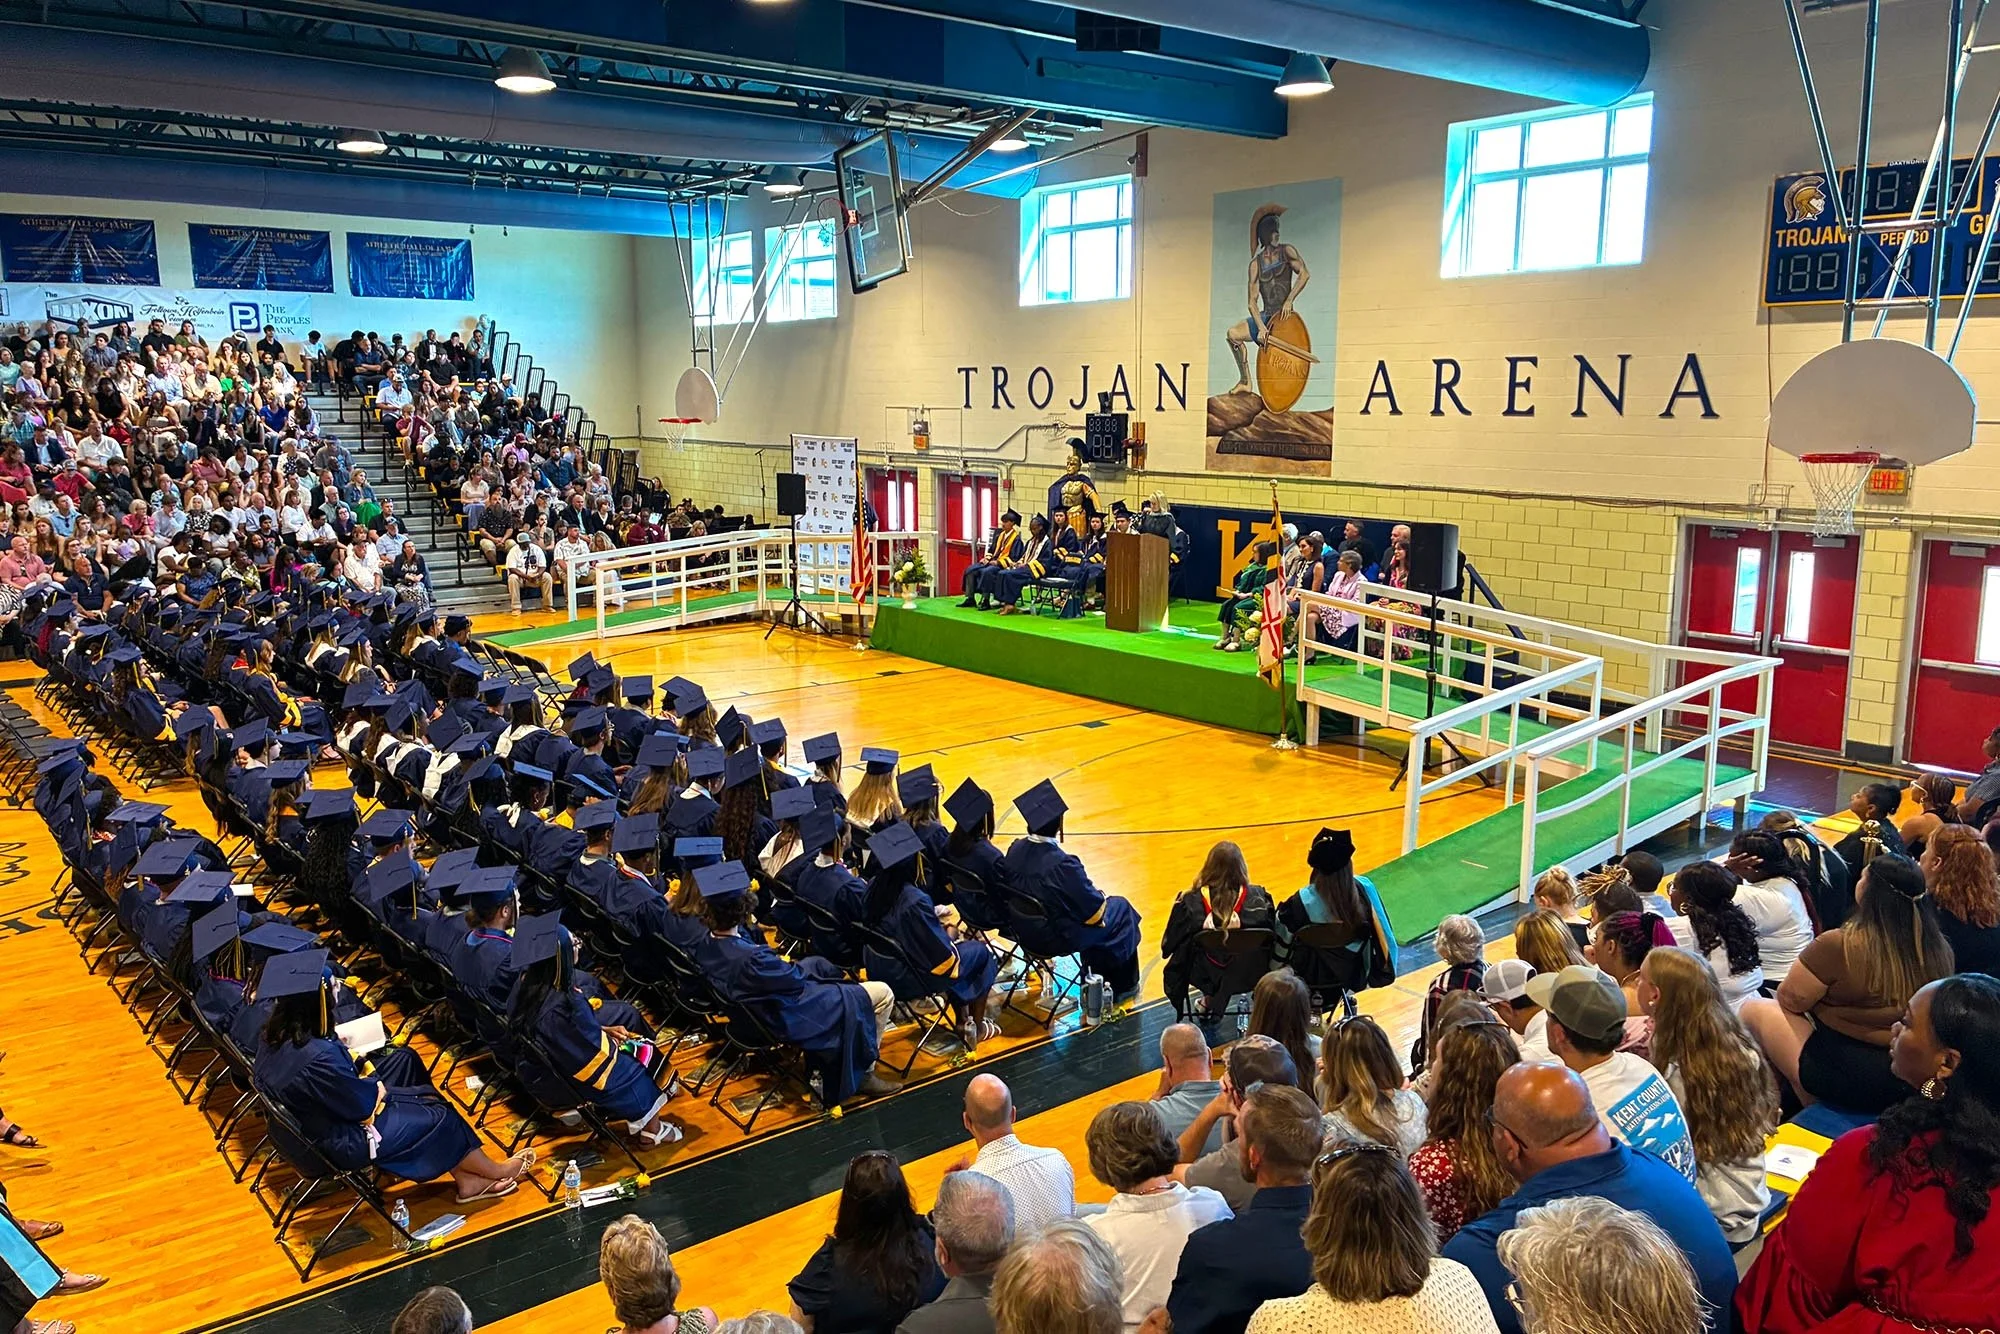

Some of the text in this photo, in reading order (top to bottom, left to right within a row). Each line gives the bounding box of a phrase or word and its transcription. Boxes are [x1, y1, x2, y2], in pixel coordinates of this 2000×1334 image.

[1776, 226, 1851, 248] TROJAN
[1880, 230, 1929, 246] PEROD
[263, 303, 286, 314] THE
[265, 313, 311, 325] PEOPLES
[272, 326, 295, 335] ANK
[957, 352, 1721, 419] TROJAN ARENA
[1872, 471, 1898, 489] EXIT
[1612, 1100, 1640, 1127] KENT
